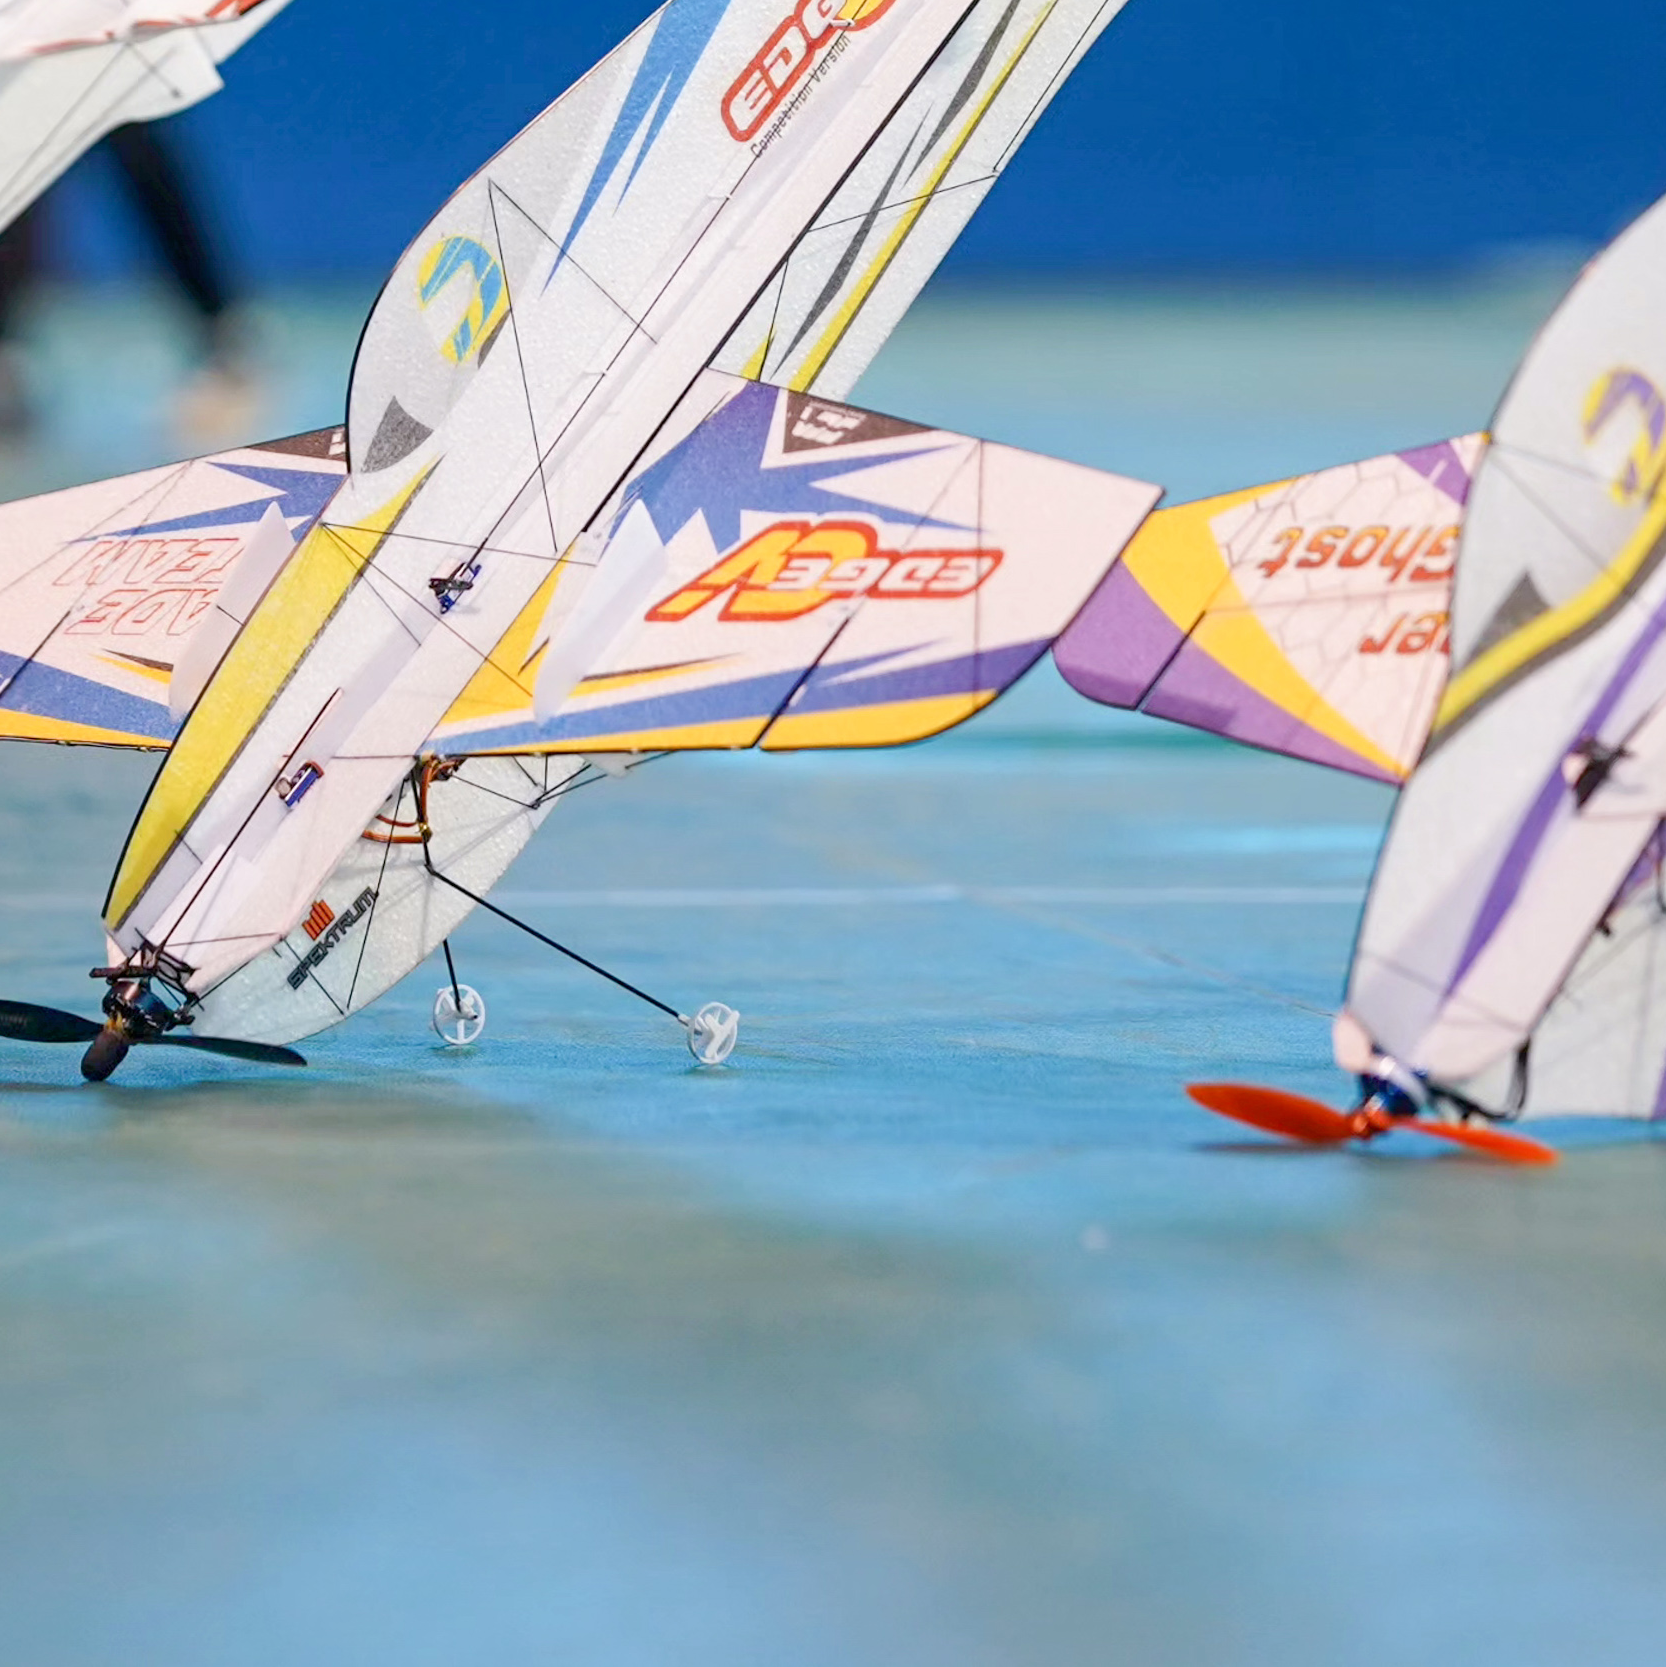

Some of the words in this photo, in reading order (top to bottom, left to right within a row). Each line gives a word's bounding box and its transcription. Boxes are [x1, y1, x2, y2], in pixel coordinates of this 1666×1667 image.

[750, 77, 815, 159] Competition
[811, 34, 851, 85] Version
[1257, 523, 1460, 584] Ghost
[286, 886, 379, 991] SPEKTRUM
